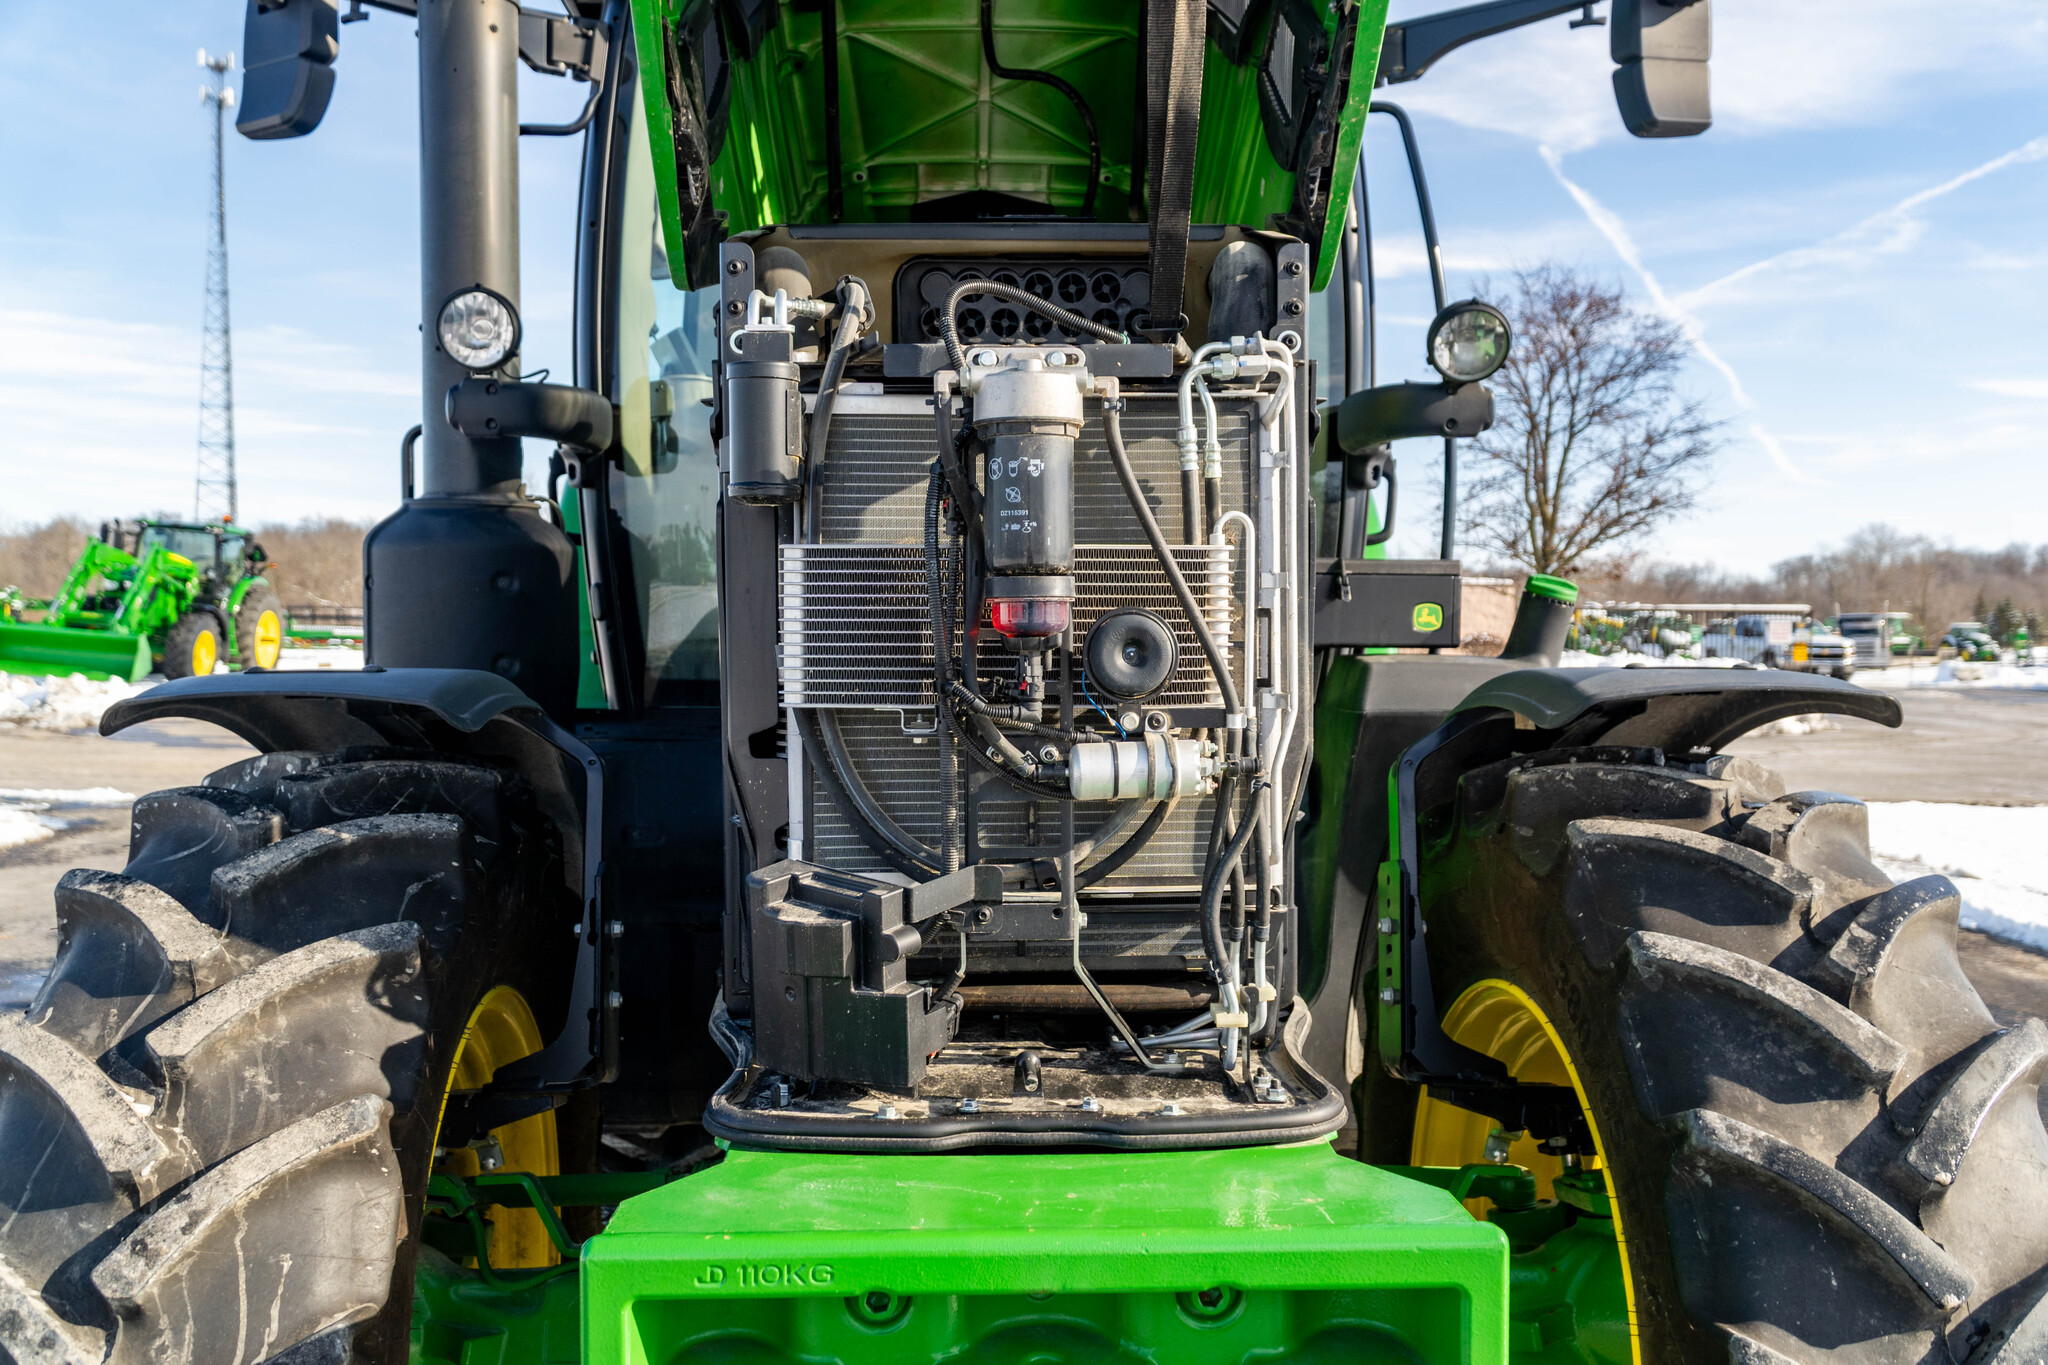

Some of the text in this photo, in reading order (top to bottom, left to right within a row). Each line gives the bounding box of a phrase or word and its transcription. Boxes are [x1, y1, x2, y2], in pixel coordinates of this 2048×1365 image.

[1000, 509, 1028, 517] DZ115391
[694, 1264, 834, 1287] JD 110KG
